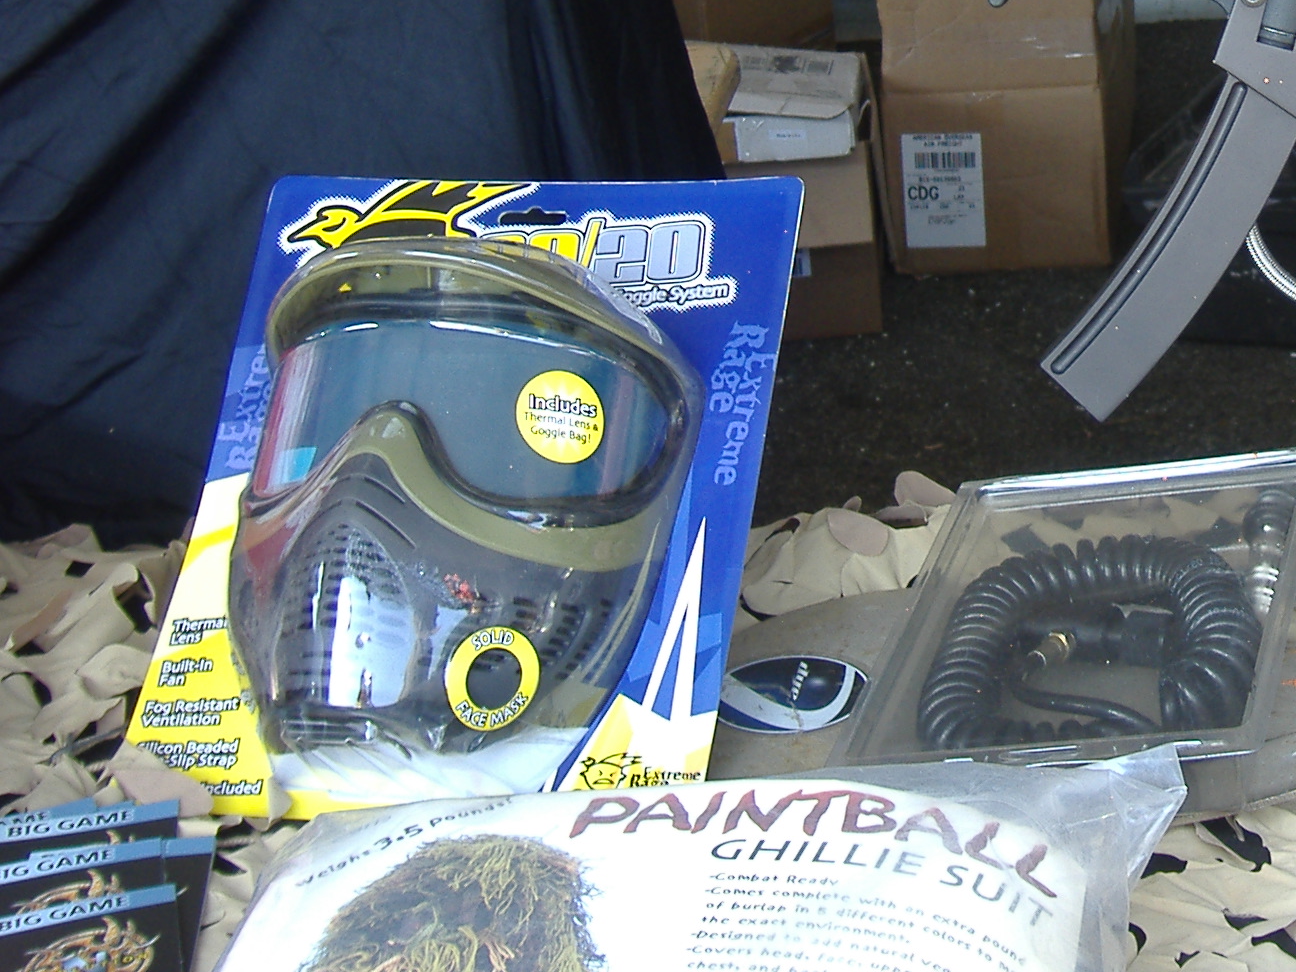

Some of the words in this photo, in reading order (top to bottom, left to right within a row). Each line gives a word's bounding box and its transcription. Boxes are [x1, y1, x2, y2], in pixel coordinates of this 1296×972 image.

[908, 186, 939, 200] CDG
[668, 282, 728, 306] System
[709, 321, 769, 413] Rage
[529, 393, 598, 418] Includes
[525, 412, 566, 425] Thermal
[569, 418, 591, 430] Lens
[714, 351, 777, 486] Extreme
[531, 425, 566, 439] Goggle
[569, 430, 591, 444] Bag!
[169, 633, 202, 646] Lens
[472, 630, 514, 650] SOLID
[162, 657, 213, 673] Built-In
[158, 674, 186, 687] Fan
[146, 700, 172, 714] Fog
[175, 697, 240, 714] Resistant
[456, 700, 489, 726] FACE
[490, 692, 529, 726] MASK
[141, 713, 221, 728] Ventilation
[186, 738, 240, 755] Beaded
[196, 754, 238, 770] Strap
[643, 767, 701, 781] Extreme
[7, 824, 50, 838] BIG
[57, 810, 133, 830] GAME
[373, 824, 424, 851] 3.5
[569, 789, 1058, 899] PAINTBALL
[36, 849, 113, 872] GAME
[709, 872, 778, 883] -Combat
[786, 874, 839, 886] Ready
[710, 839, 927, 877] GHILLIE
[939, 865, 1055, 927] SUIT
[50, 896, 128, 920] GAME
[705, 886, 765, 897] -Comes
[772, 889, 851, 903] complete
[859, 897, 897, 909] with
[905, 905, 925, 916] an
[932, 913, 976, 935] extra
[701, 916, 730, 926] the
[738, 917, 787, 927] exact
[706, 901, 724, 910] of
[731, 902, 787, 913] burlap
[795, 904, 810, 914] in
[836, 909, 915, 928] different
[923, 926, 972, 950] colors
[977, 948, 993, 962] to
[783, 933, 802, 943] to
[811, 937, 842, 948] add
[850, 942, 915, 962] natural
